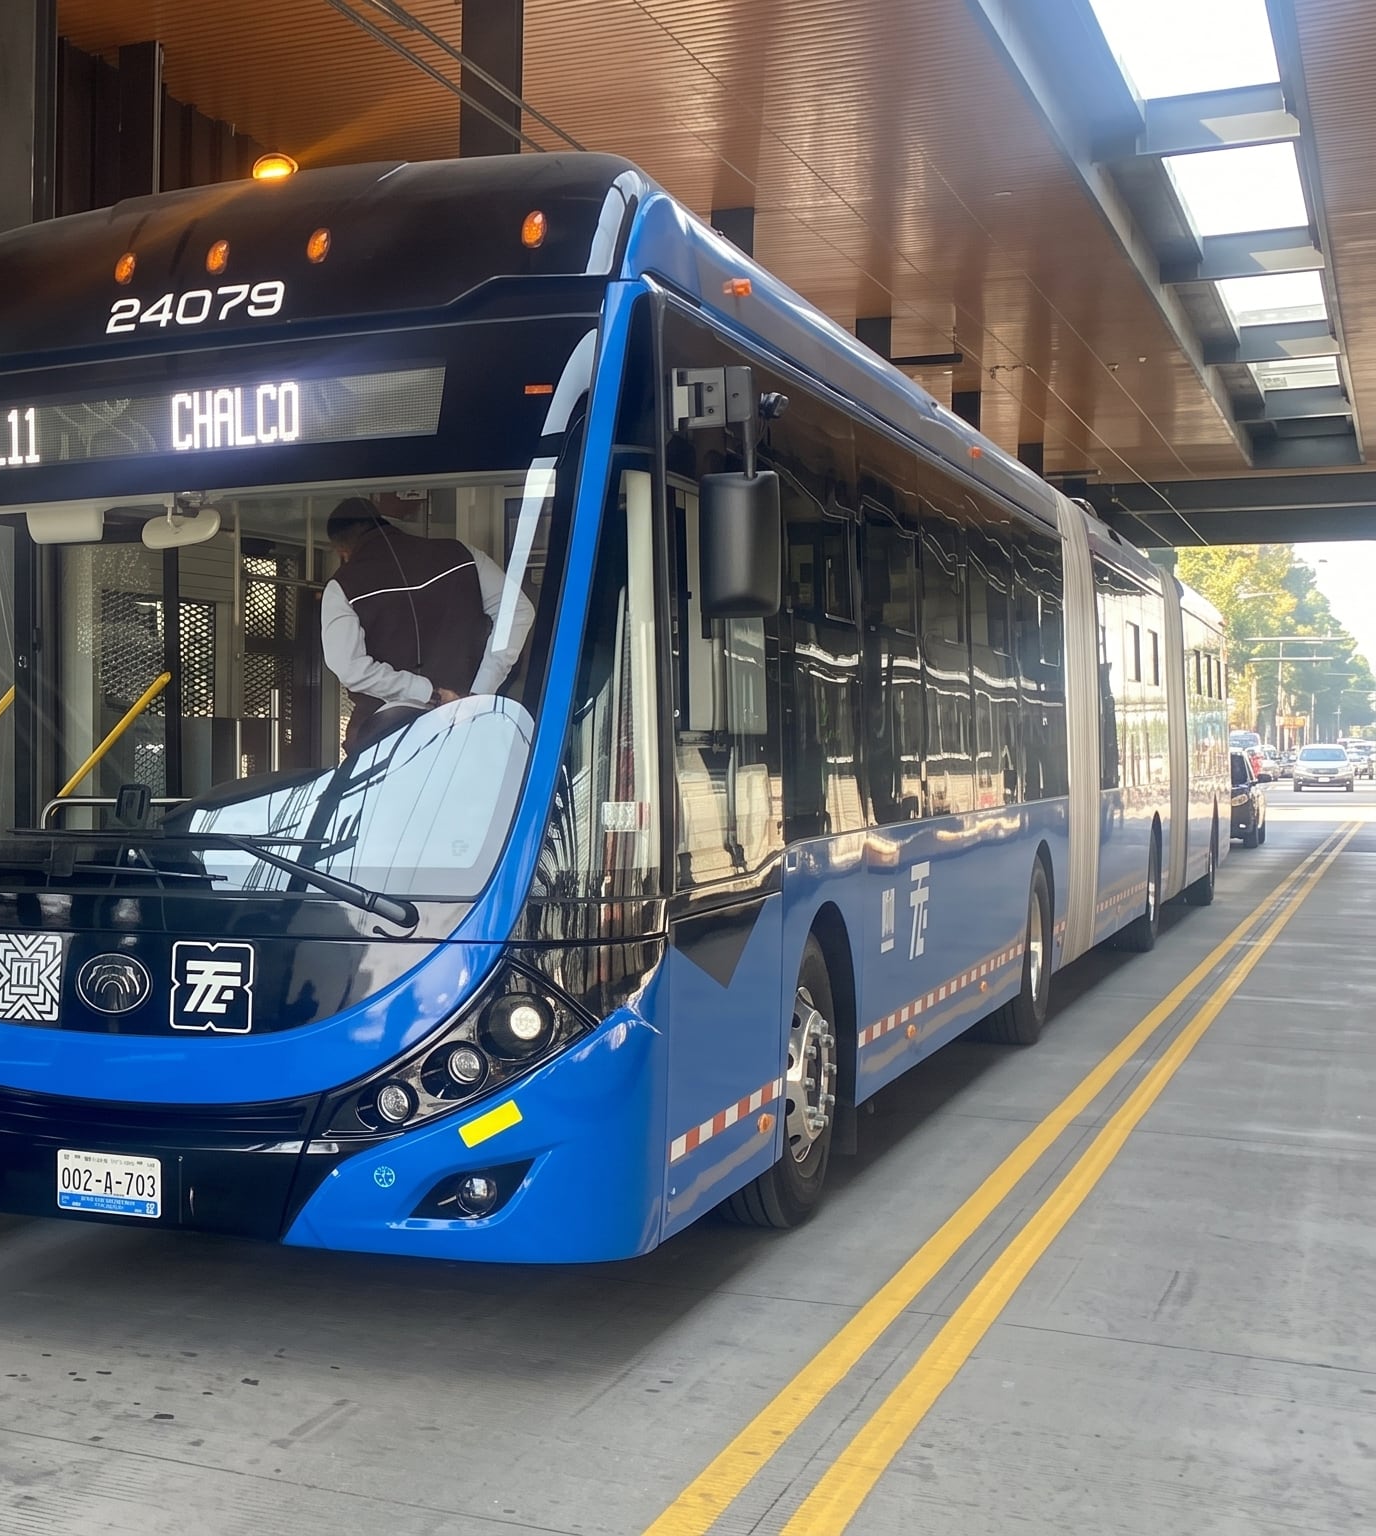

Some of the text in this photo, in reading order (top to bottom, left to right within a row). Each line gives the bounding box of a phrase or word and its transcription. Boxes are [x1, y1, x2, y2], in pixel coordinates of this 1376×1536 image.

[105, 280, 285, 334] 24079
[171, 381, 301, 452] CHALCO
[61, 1167, 156, 1198] 002-A-703
